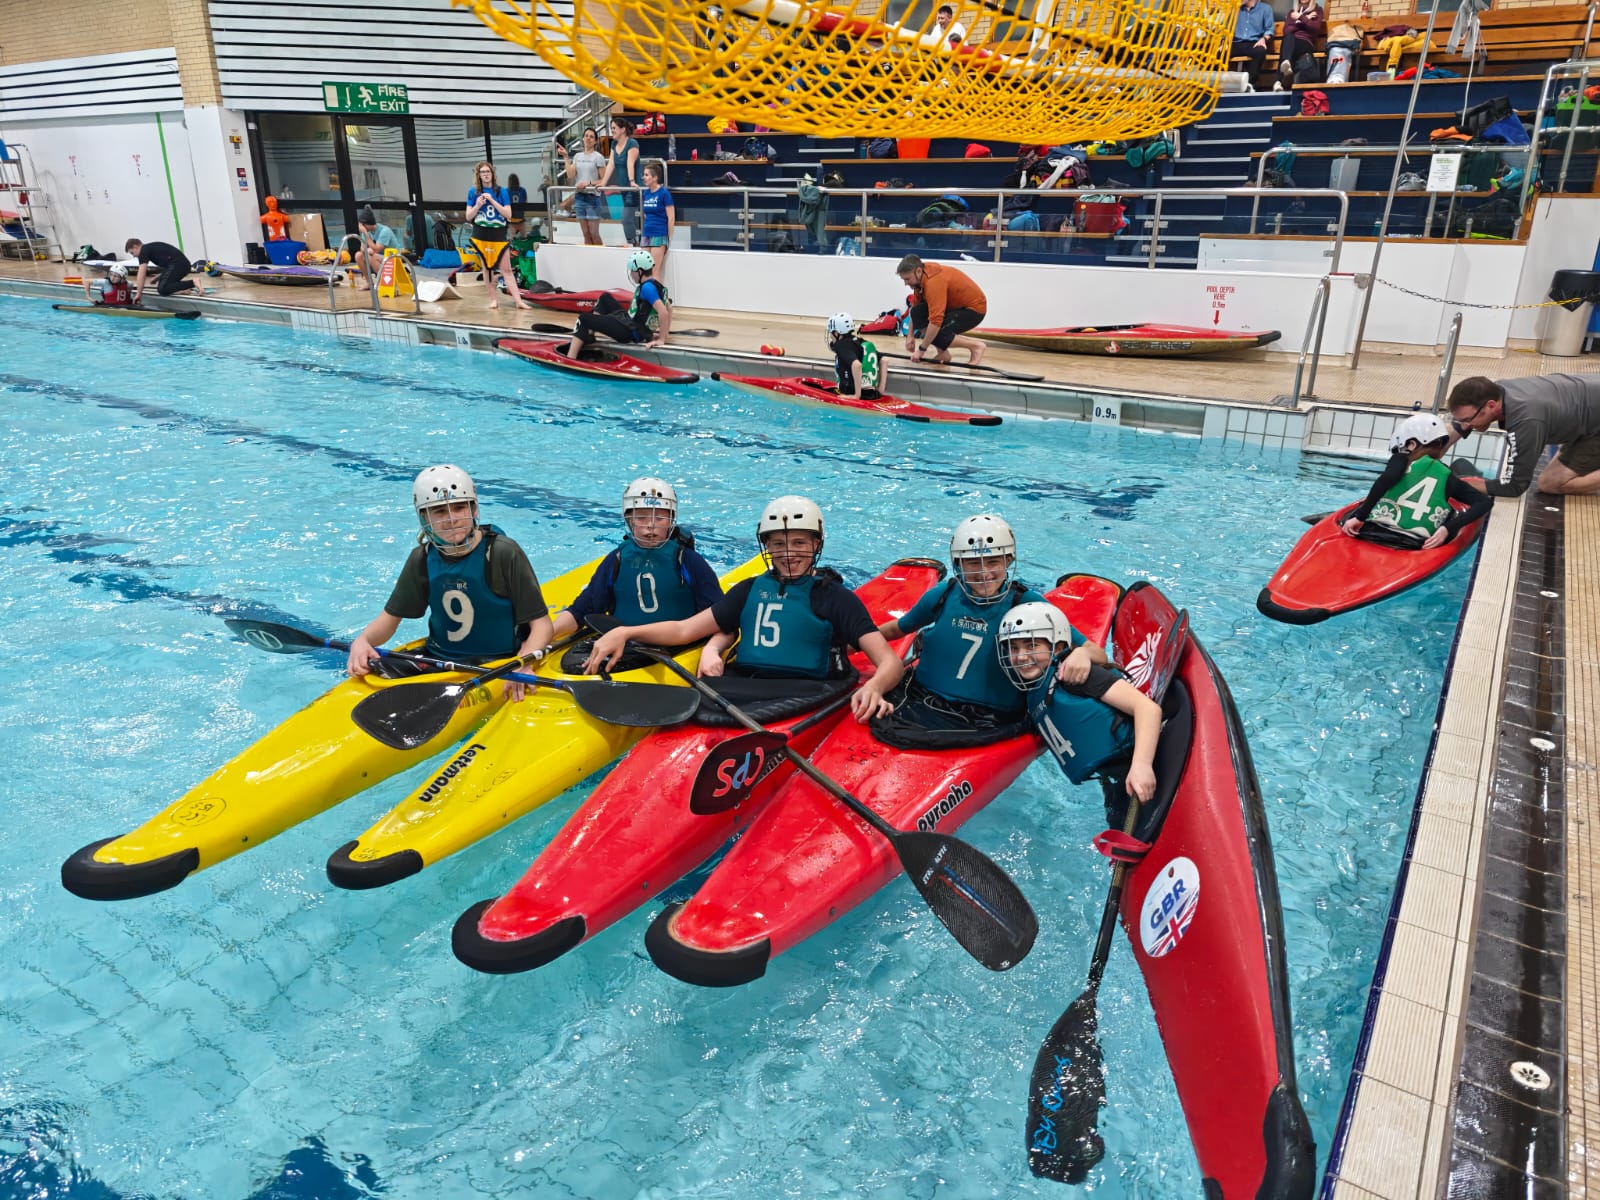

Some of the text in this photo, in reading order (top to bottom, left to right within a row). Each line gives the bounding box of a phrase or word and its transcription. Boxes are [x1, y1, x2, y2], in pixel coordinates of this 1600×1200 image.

[377, 85, 406, 97] FIRE
[379, 100, 406, 112] EXIT
[486, 205, 496, 218] 8
[116, 289, 127, 302] 19
[1206, 285, 1235, 294] POOL DEPTH
[867, 352, 878, 381] 3
[1094, 406, 1117, 420] 0.9m
[1396, 476, 1438, 521] 4
[442, 589, 475, 642] 9
[753, 602, 784, 648] 15
[956, 632, 984, 680] 7
[1037, 714, 1076, 767] 14
[417, 743, 487, 803] Lettmann
[1149, 877, 1187, 930] GBR
